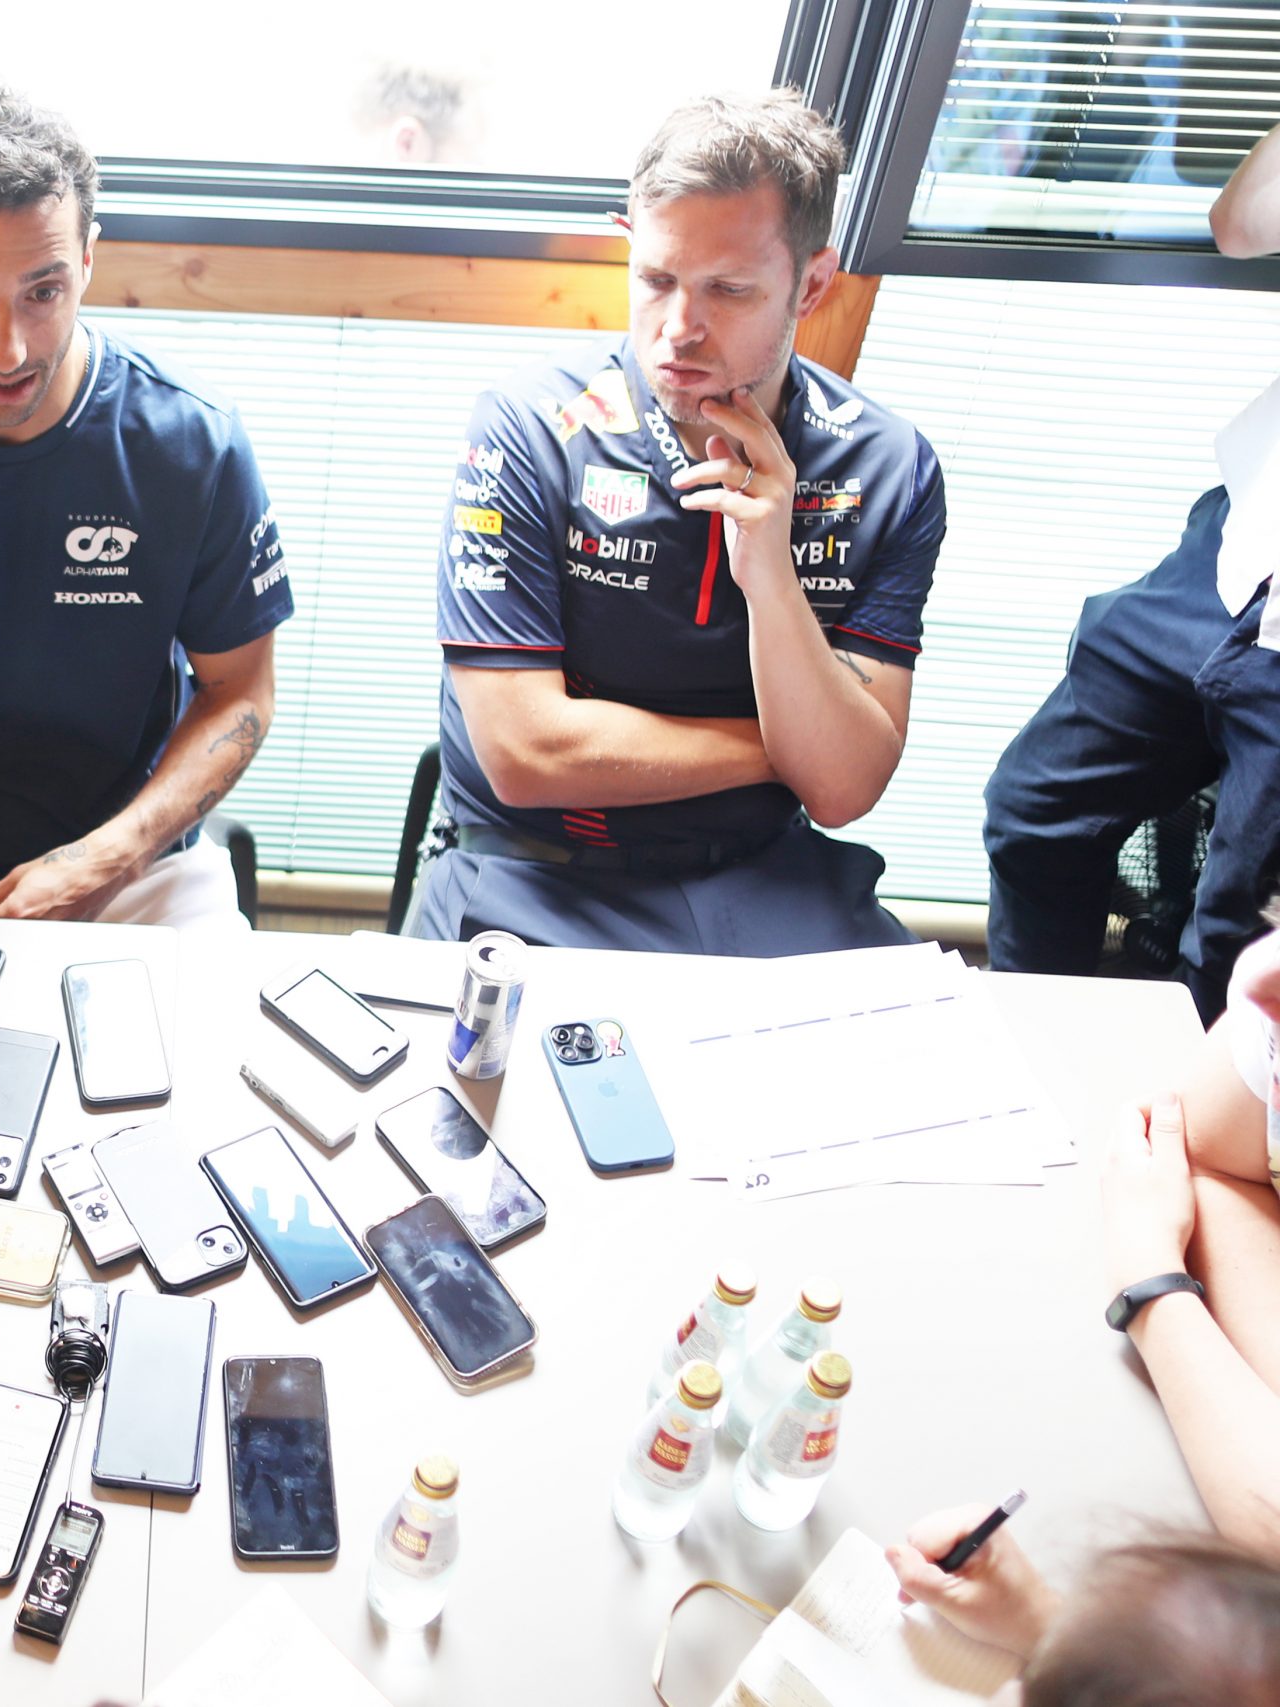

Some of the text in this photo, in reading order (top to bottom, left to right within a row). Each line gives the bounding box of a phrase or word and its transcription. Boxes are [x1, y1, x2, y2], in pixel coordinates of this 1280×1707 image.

[795, 478, 862, 496] RACLE
[566, 525, 630, 561] Mobil
[792, 535, 851, 566] YBIT
[63, 566, 129, 576] ALPHATAURI
[800, 577, 855, 591] NDA
[54, 591, 144, 605] HONDA
